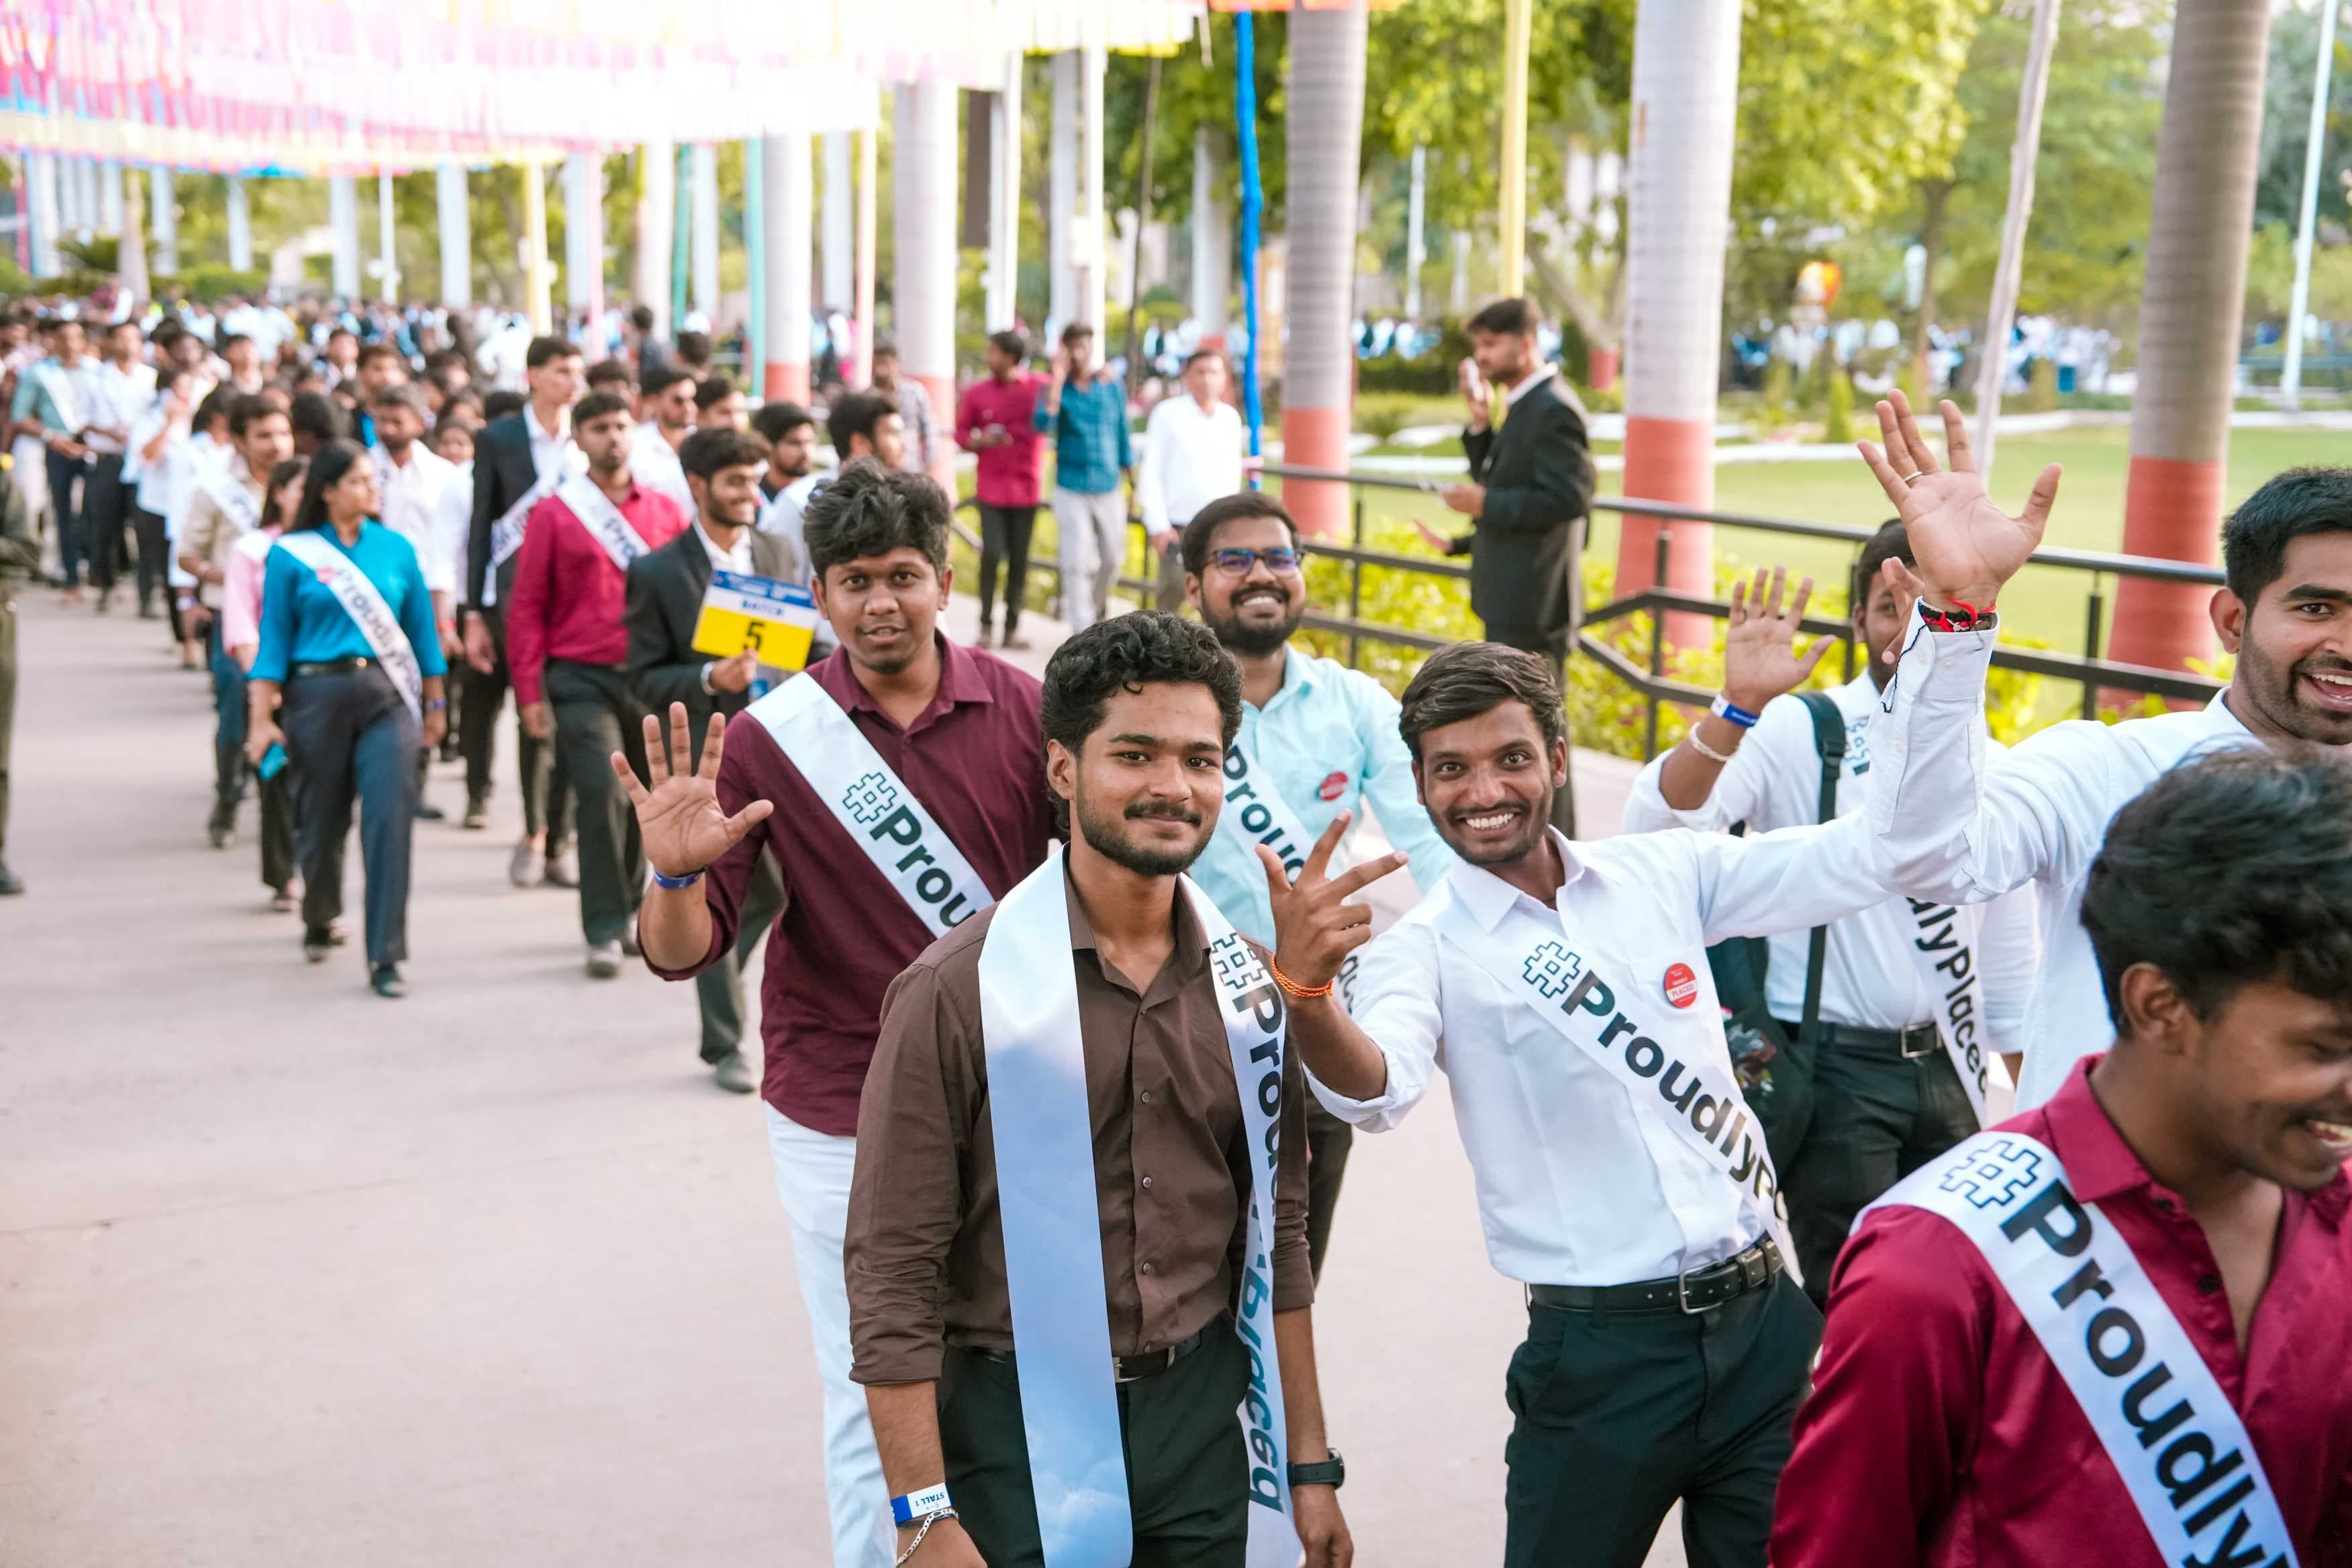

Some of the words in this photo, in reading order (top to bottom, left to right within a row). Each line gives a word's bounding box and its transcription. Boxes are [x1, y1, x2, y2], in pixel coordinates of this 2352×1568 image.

[742, 620, 765, 651] 5
[1939, 1140, 2288, 1568] #Proudly
[920, 1492, 944, 1505] STALL
